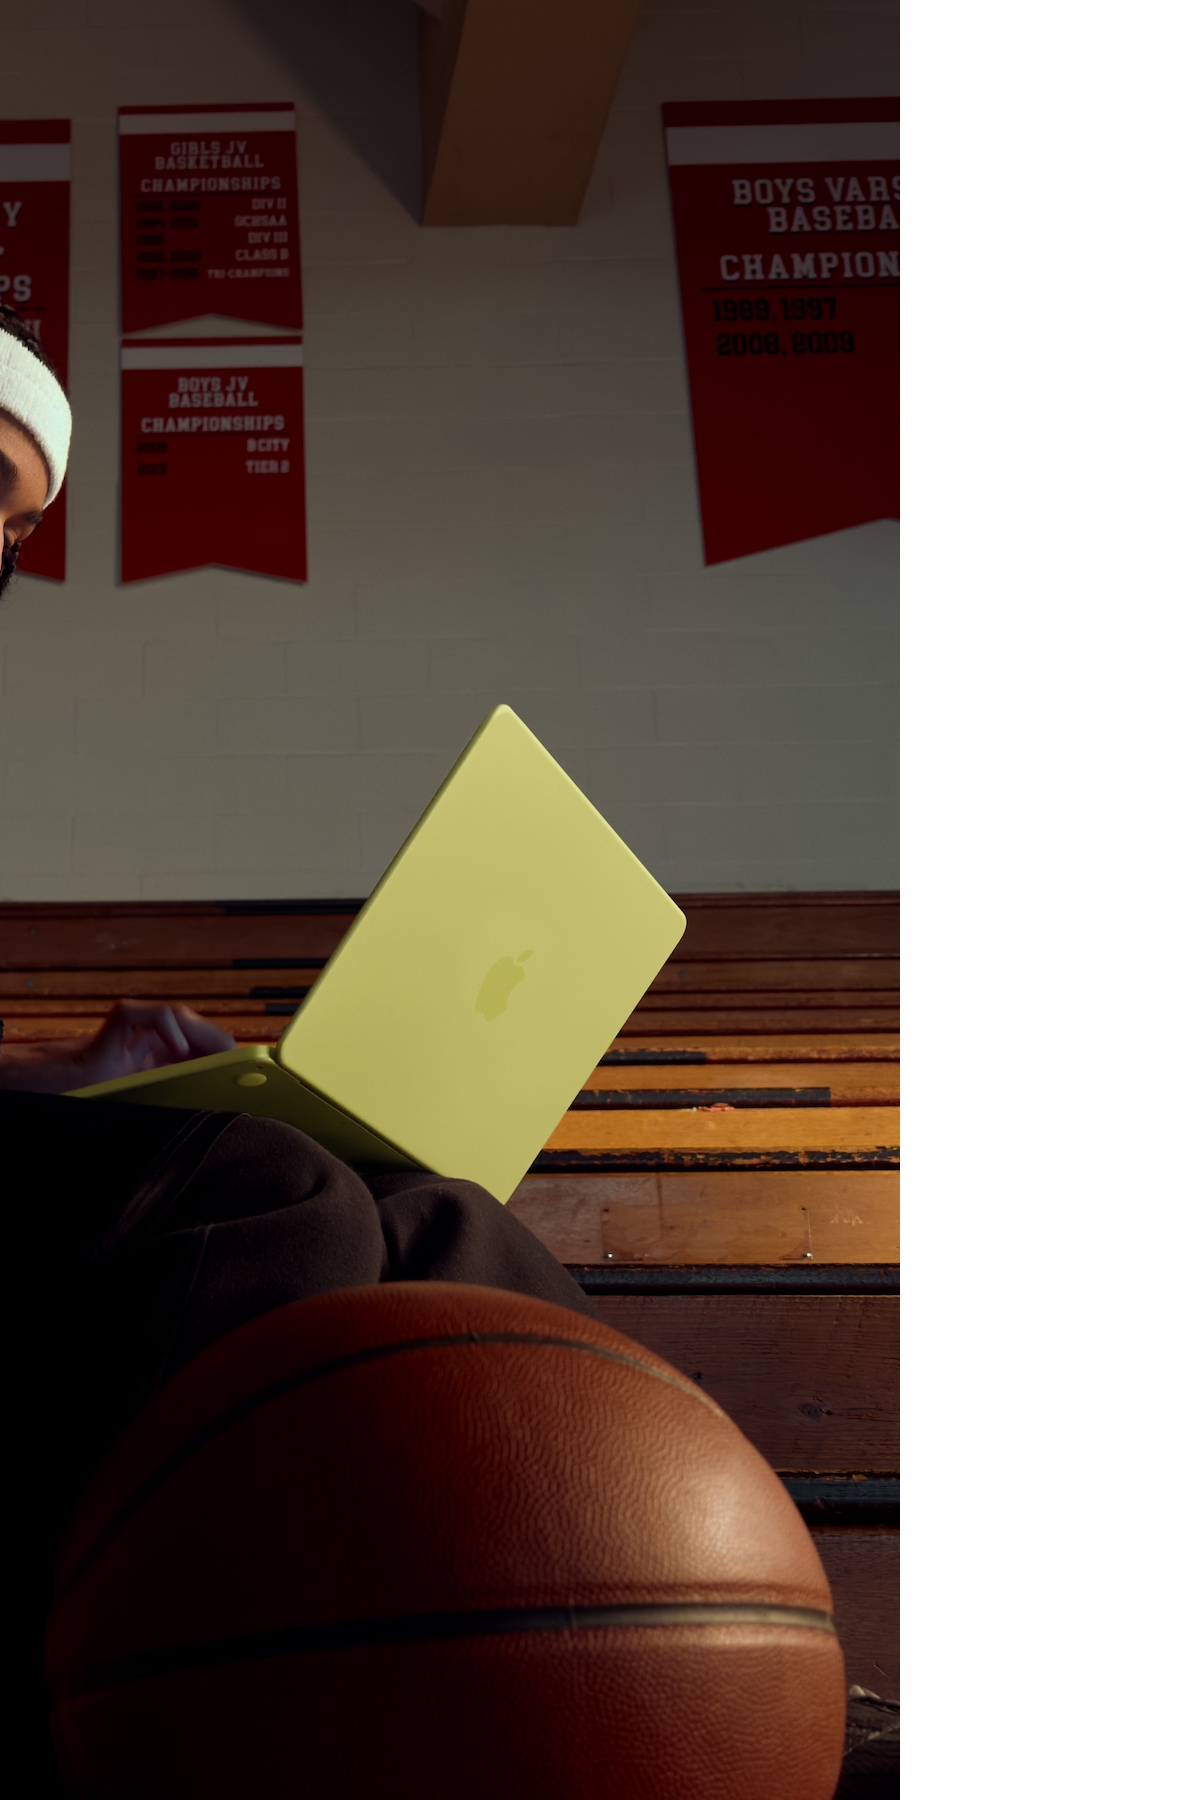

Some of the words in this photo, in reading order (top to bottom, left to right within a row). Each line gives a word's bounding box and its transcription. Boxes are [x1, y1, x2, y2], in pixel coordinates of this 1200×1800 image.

[170, 141, 221, 155] GIRLS
[224, 140, 247, 154] JV
[154, 155, 265, 170] BASKETBALL
[140, 176, 281, 193] CHAMPIONSHIPS
[731, 178, 816, 205] BOYS
[767, 205, 900, 233] BASEBA
[234, 248, 278, 261] CLASS
[720, 251, 900, 281] CHAMPION
[177, 376, 222, 392] BOYS
[225, 375, 249, 392] JV
[168, 392, 259, 408] BASEBALL
[140, 415, 285, 433] CHAMPIONSHIPS
